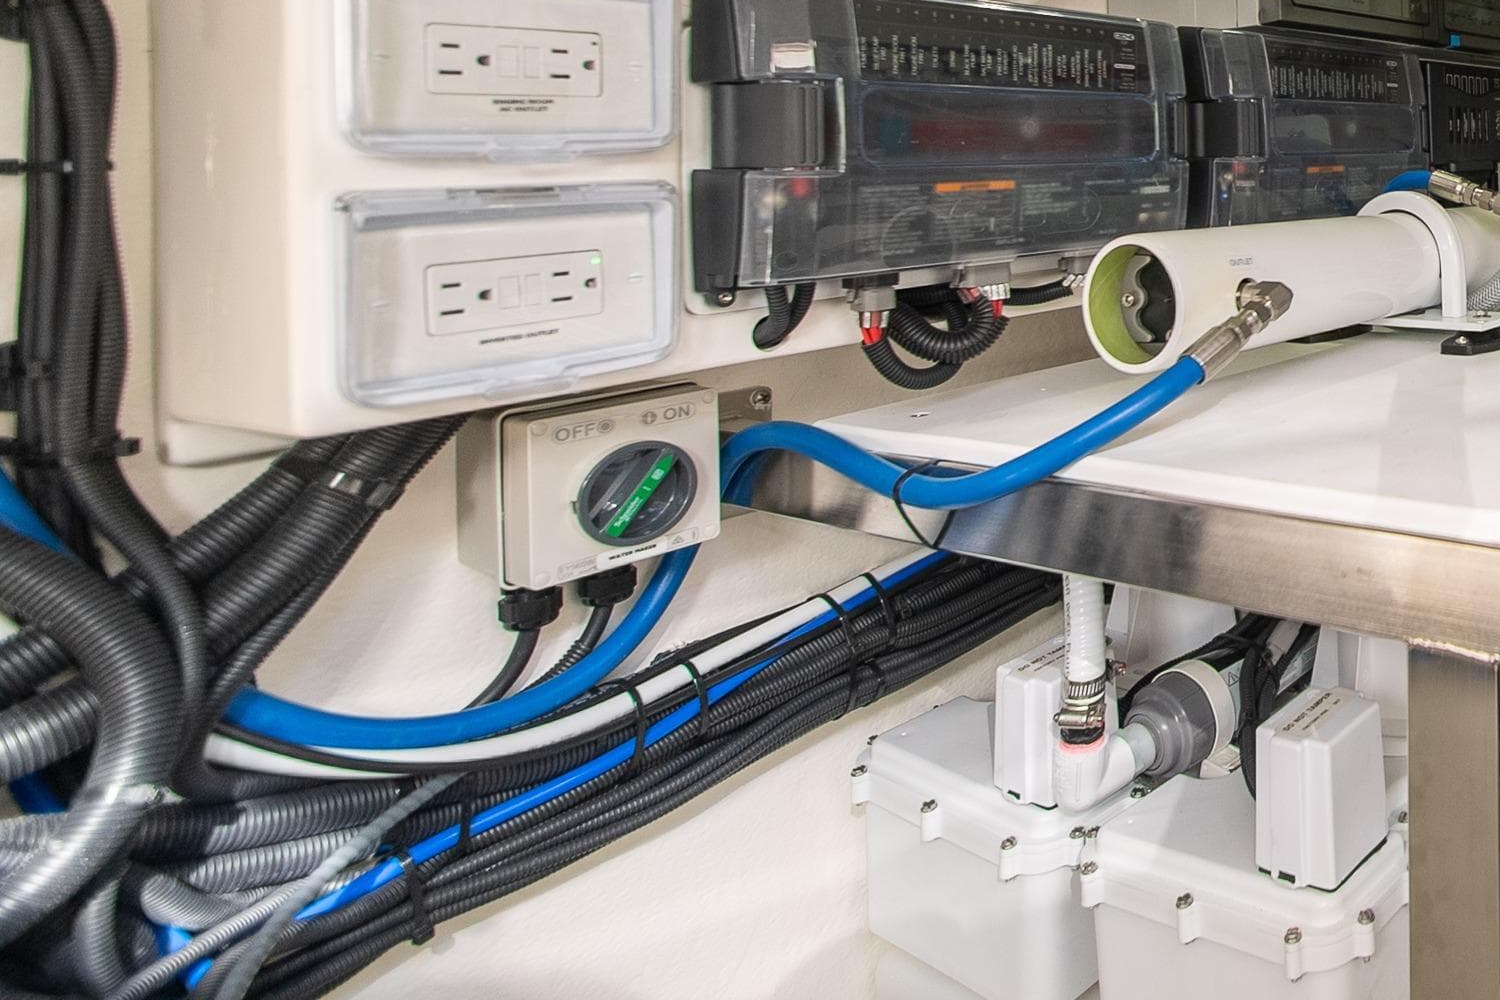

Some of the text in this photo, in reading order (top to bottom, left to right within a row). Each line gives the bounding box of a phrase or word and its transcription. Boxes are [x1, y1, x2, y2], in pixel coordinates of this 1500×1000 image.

[663, 404, 691, 422] ON
[554, 421, 598, 443] OFF
[1282, 722, 1295, 732] DO
[1294, 711, 1308, 723] NOT
